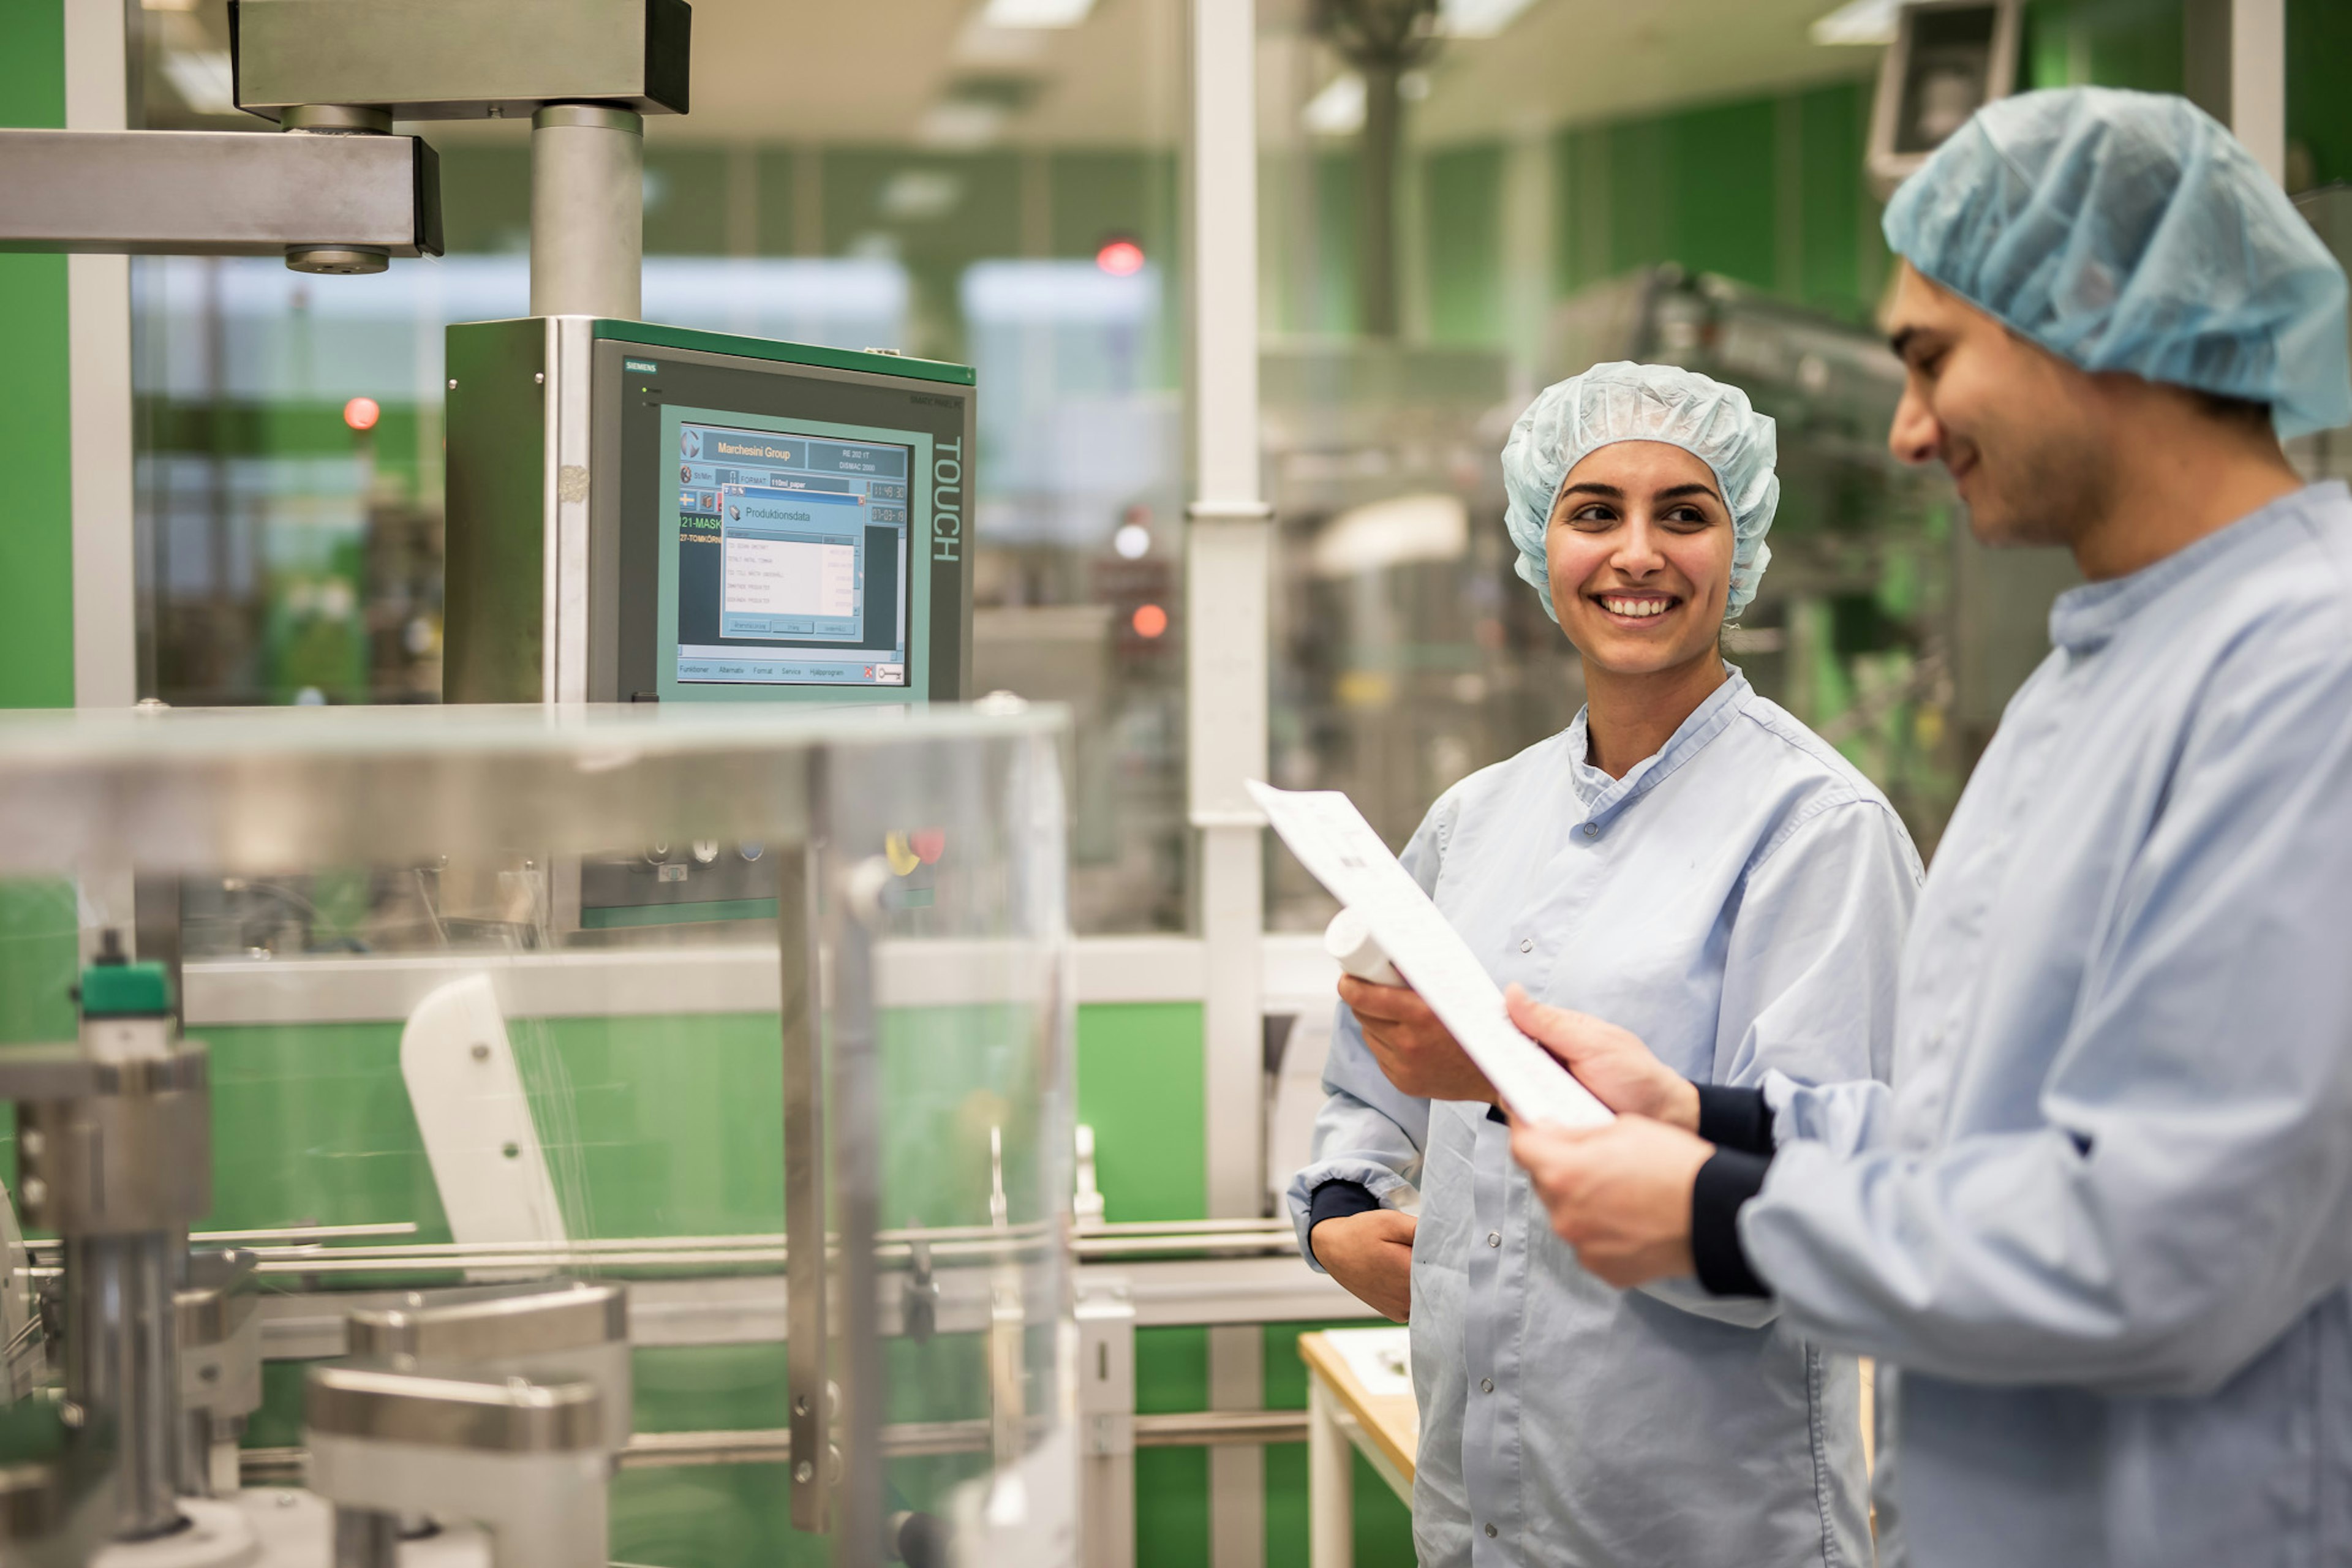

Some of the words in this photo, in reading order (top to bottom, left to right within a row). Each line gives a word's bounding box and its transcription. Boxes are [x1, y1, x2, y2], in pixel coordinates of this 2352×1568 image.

[627, 361, 657, 372] SIEMENS
[718, 442, 764, 457] Marchesini
[765, 447, 791, 462] Group
[934, 437, 961, 561] TOUCH
[746, 507, 810, 522] Produktionsdata
[679, 665, 709, 674] Funktioner
